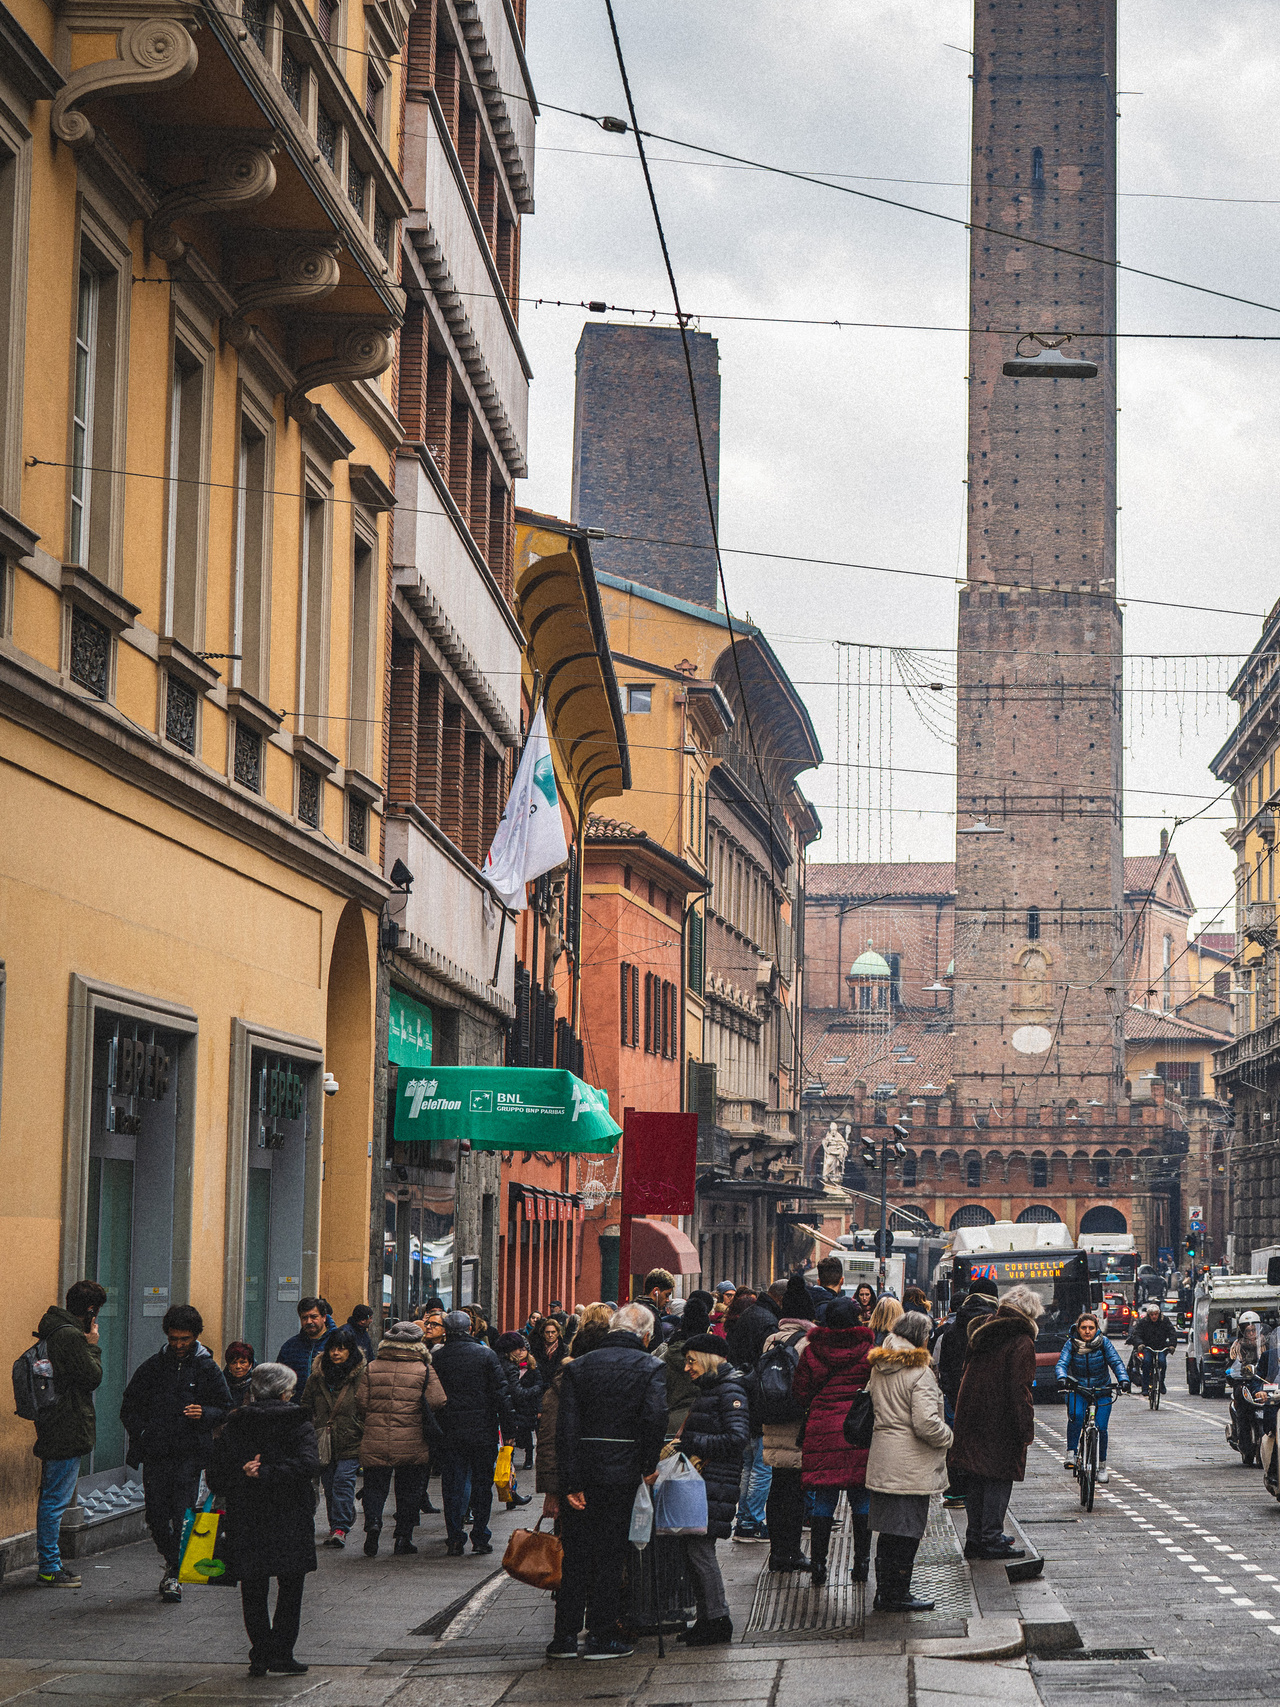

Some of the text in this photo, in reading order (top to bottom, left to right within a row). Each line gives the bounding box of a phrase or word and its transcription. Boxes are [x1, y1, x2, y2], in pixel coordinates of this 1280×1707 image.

[497, 1093, 524, 1104] BNL
[496, 1105, 524, 1113] GRUPPO
[1004, 1261, 1065, 1271] CORTICELLA
[970, 1264, 999, 1280] 27A
[1009, 1269, 1061, 1279] VIA BYRON
